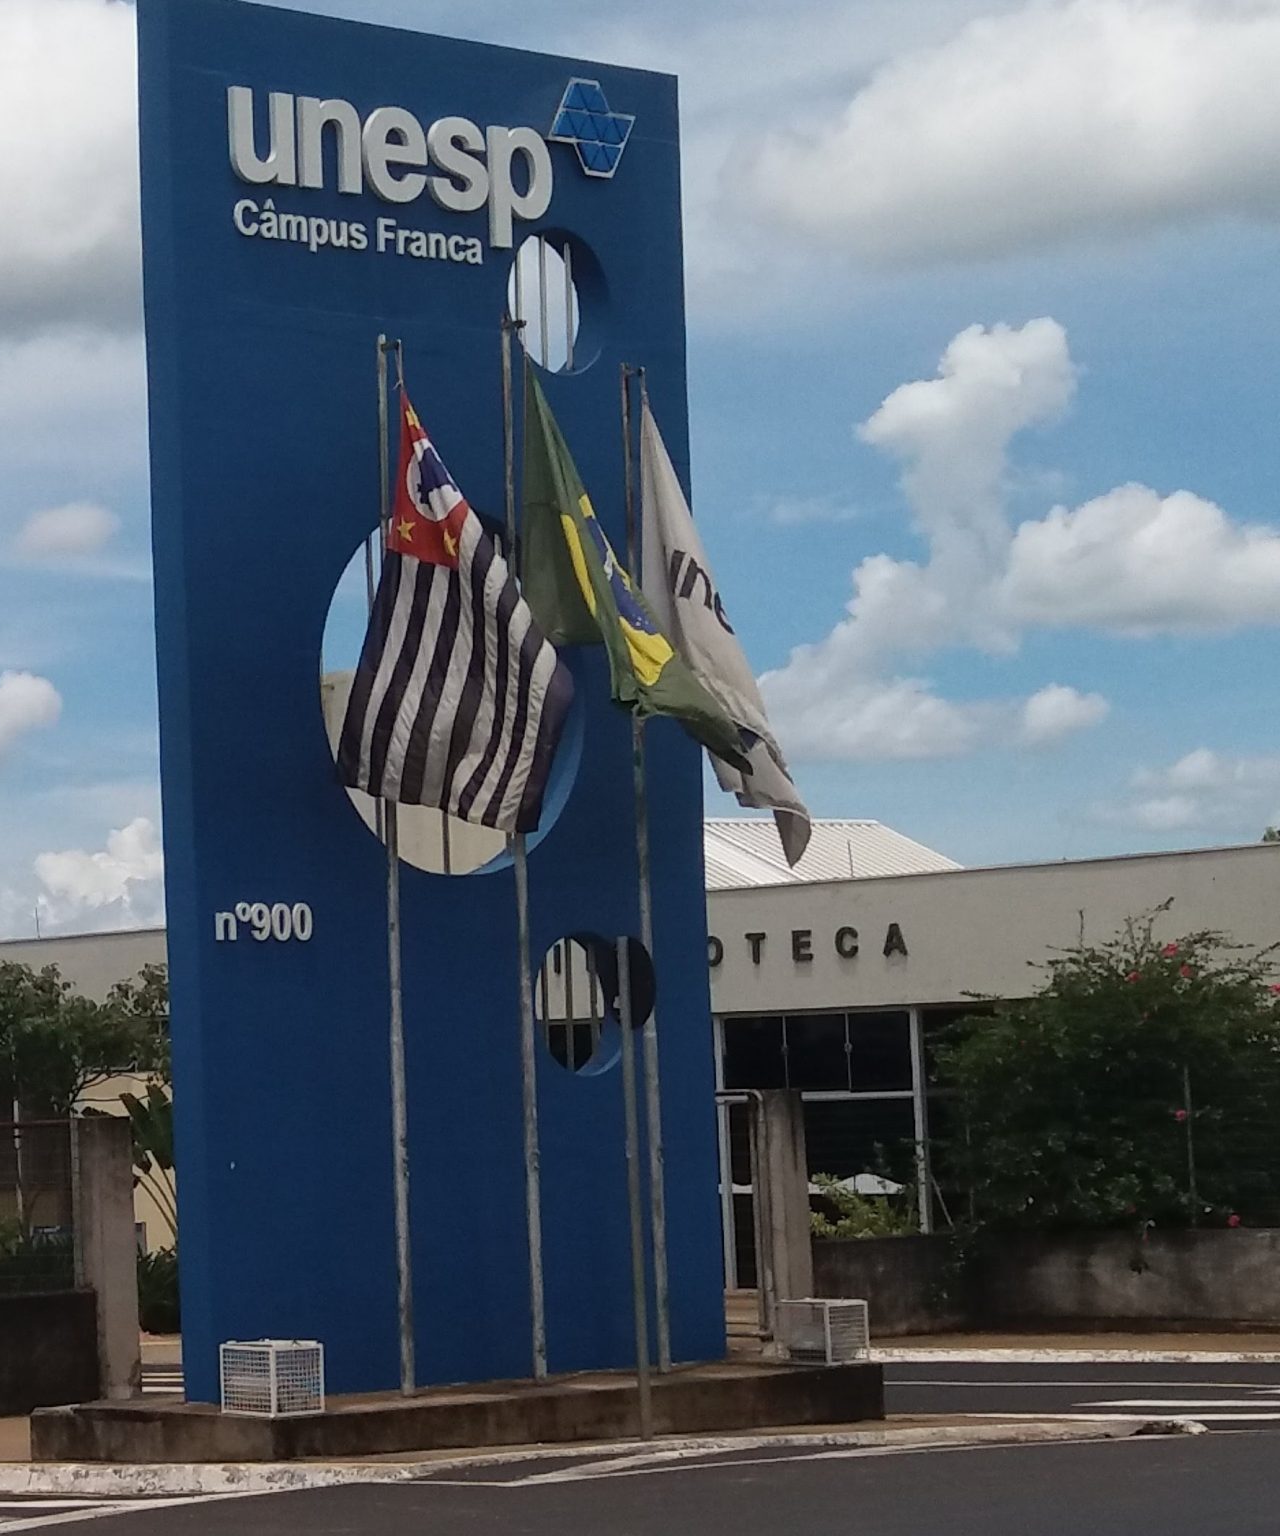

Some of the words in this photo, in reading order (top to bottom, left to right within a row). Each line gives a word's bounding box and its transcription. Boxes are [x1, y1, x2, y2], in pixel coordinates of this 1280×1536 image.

[227, 85, 553, 249] unesp
[233, 198, 368, 253] Câmpus
[376, 217, 483, 265] Franca
